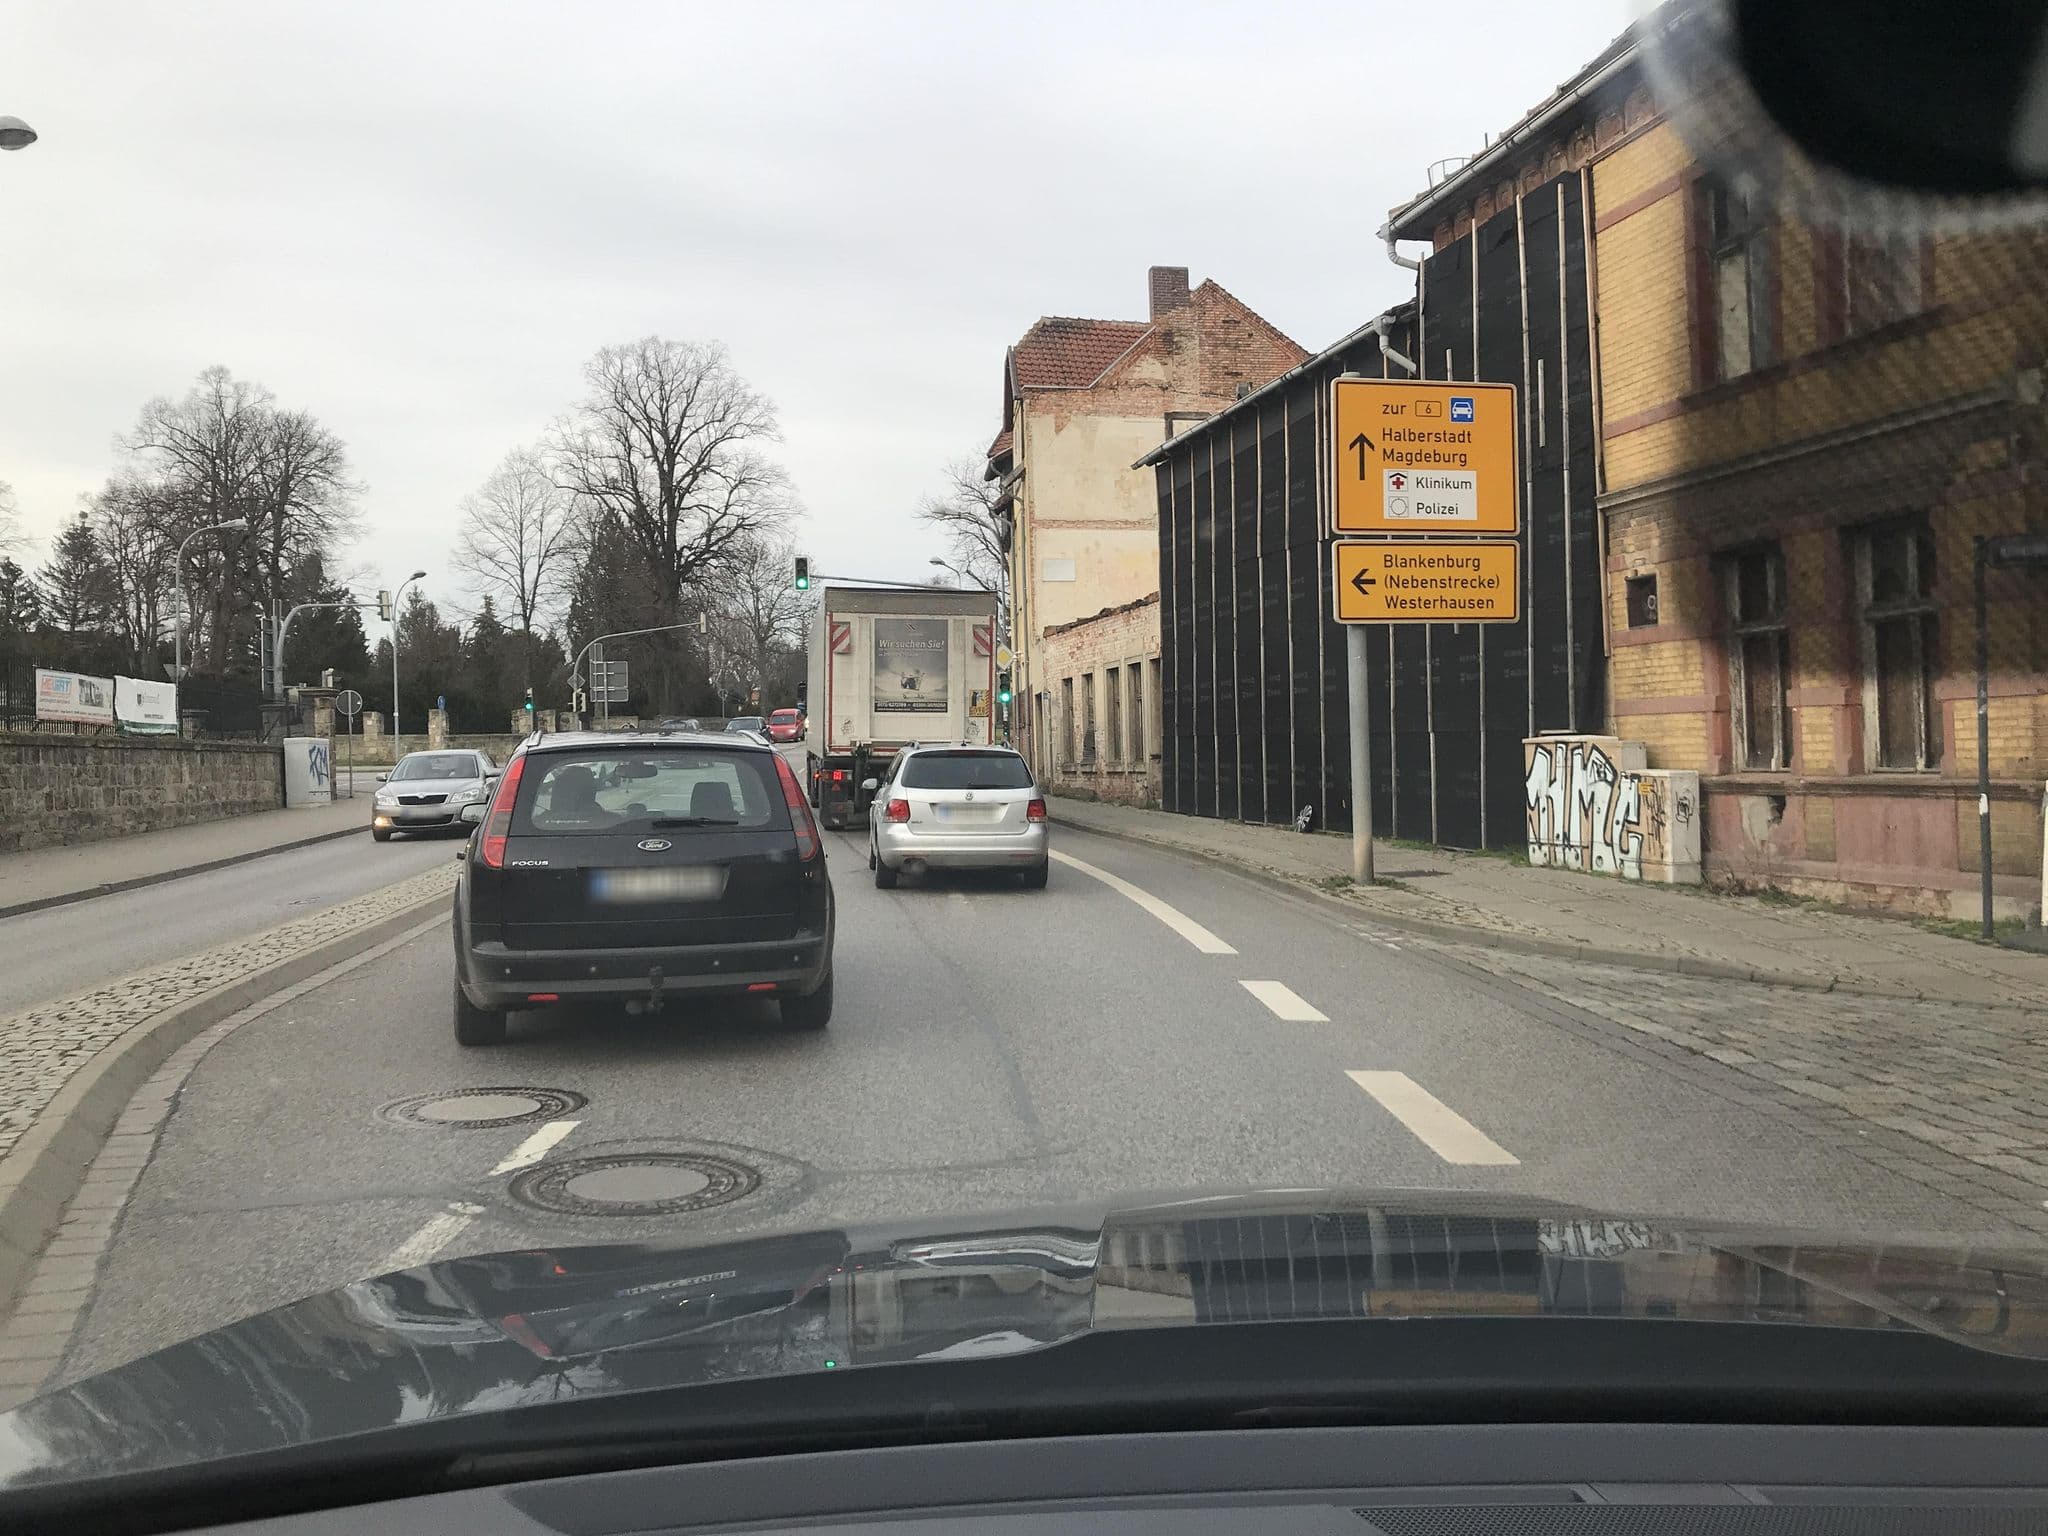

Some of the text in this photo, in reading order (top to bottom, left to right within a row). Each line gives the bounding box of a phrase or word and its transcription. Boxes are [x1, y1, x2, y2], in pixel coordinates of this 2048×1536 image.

[1382, 403, 1432, 415] zur 6
[1382, 427, 1472, 444] Halberstadt
[1382, 447, 1467, 467] Magdeburg
[1415, 476, 1473, 490] Klinikum
[1416, 502, 1459, 515] Polizei
[1383, 553, 1481, 572] Blankenburg
[1384, 573, 1500, 589] (Nebenstrecke)
[1384, 594, 1495, 609] Westerhausen
[879, 639, 893, 649] Wir
[895, 639, 926, 649] suchen
